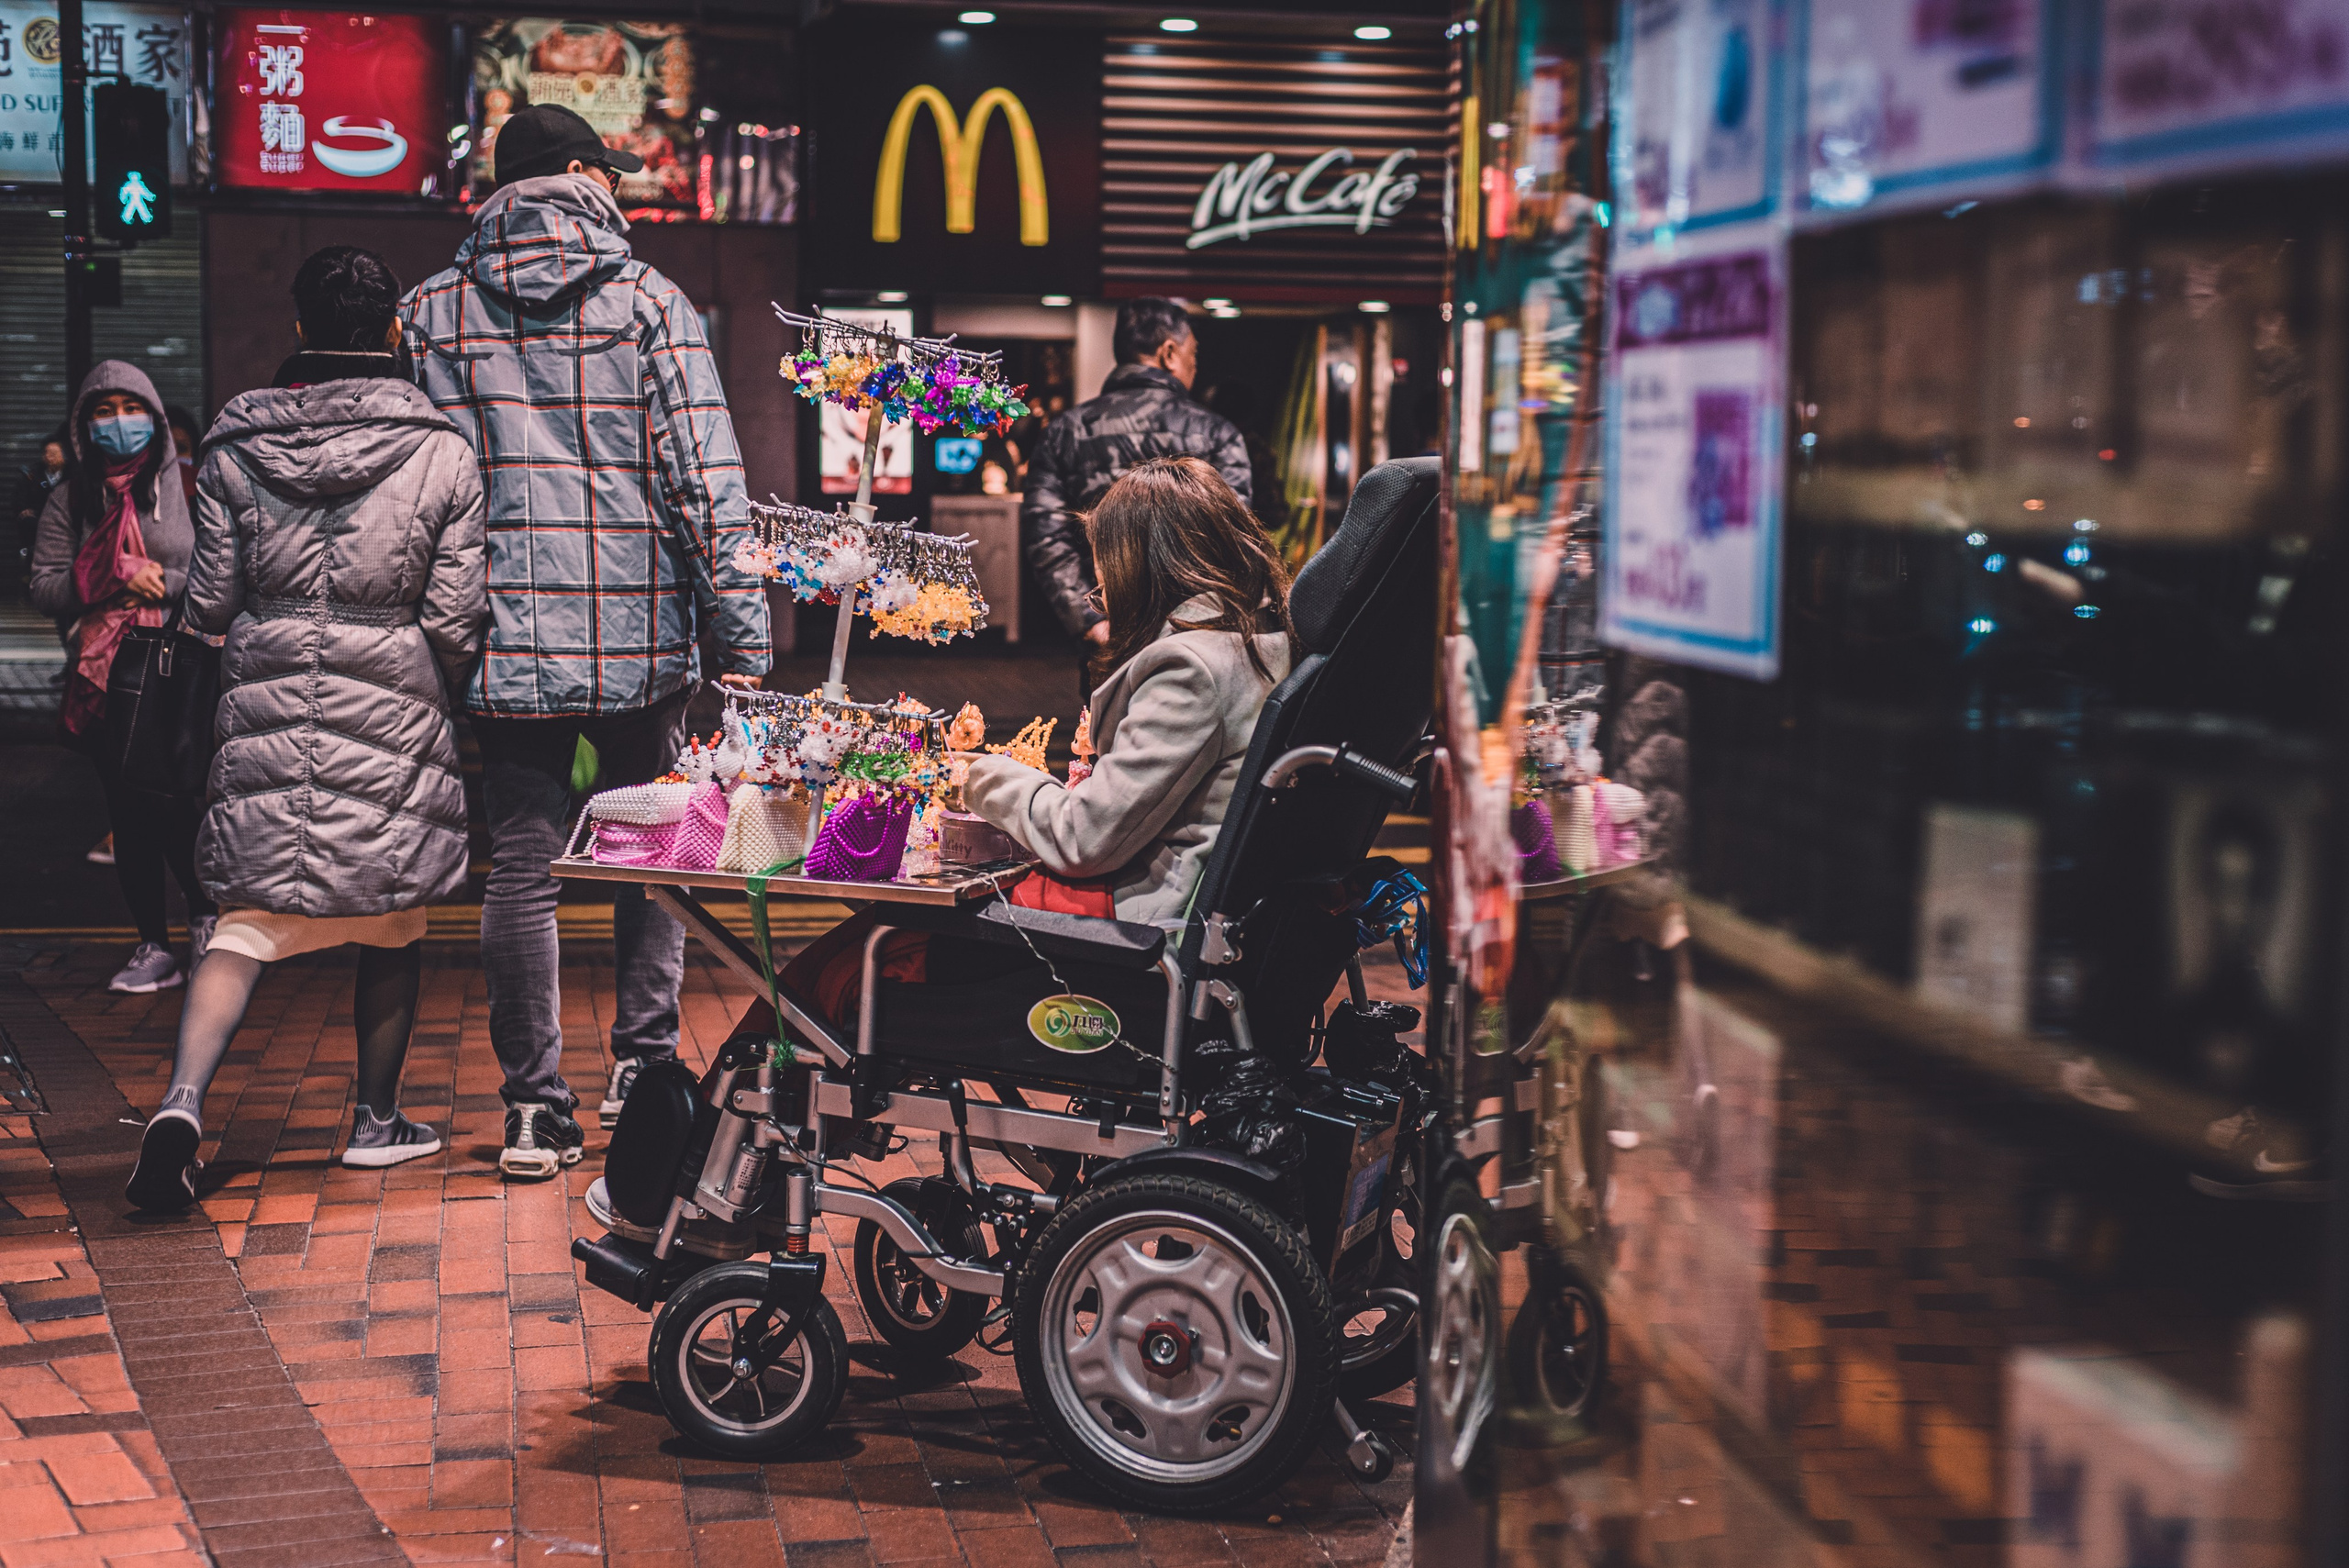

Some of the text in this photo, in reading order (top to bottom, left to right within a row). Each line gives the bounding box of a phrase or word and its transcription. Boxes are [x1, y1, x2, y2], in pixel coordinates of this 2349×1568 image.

[83, 23, 181, 82] 酒家
[257, 25, 306, 153] 一粥麵
